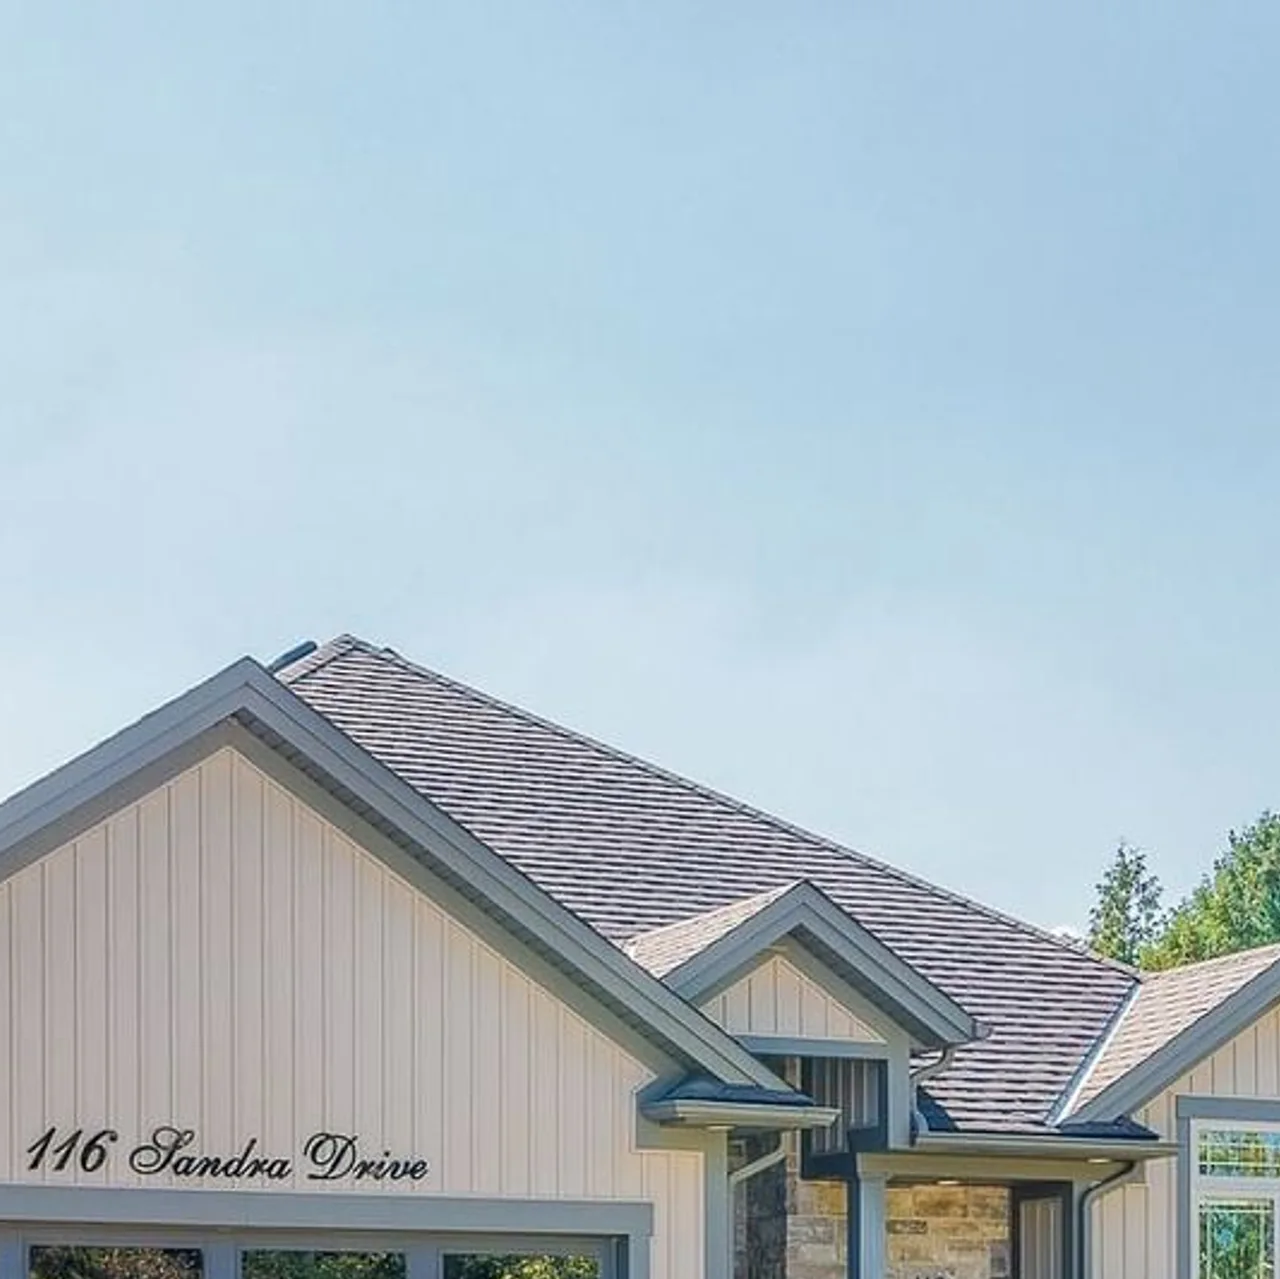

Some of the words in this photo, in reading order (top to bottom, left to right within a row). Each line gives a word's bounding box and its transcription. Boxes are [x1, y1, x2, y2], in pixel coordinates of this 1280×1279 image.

[26, 1126, 118, 1172] 116
[129, 1126, 293, 1179] Sandra
[303, 1132, 428, 1180] Drive
